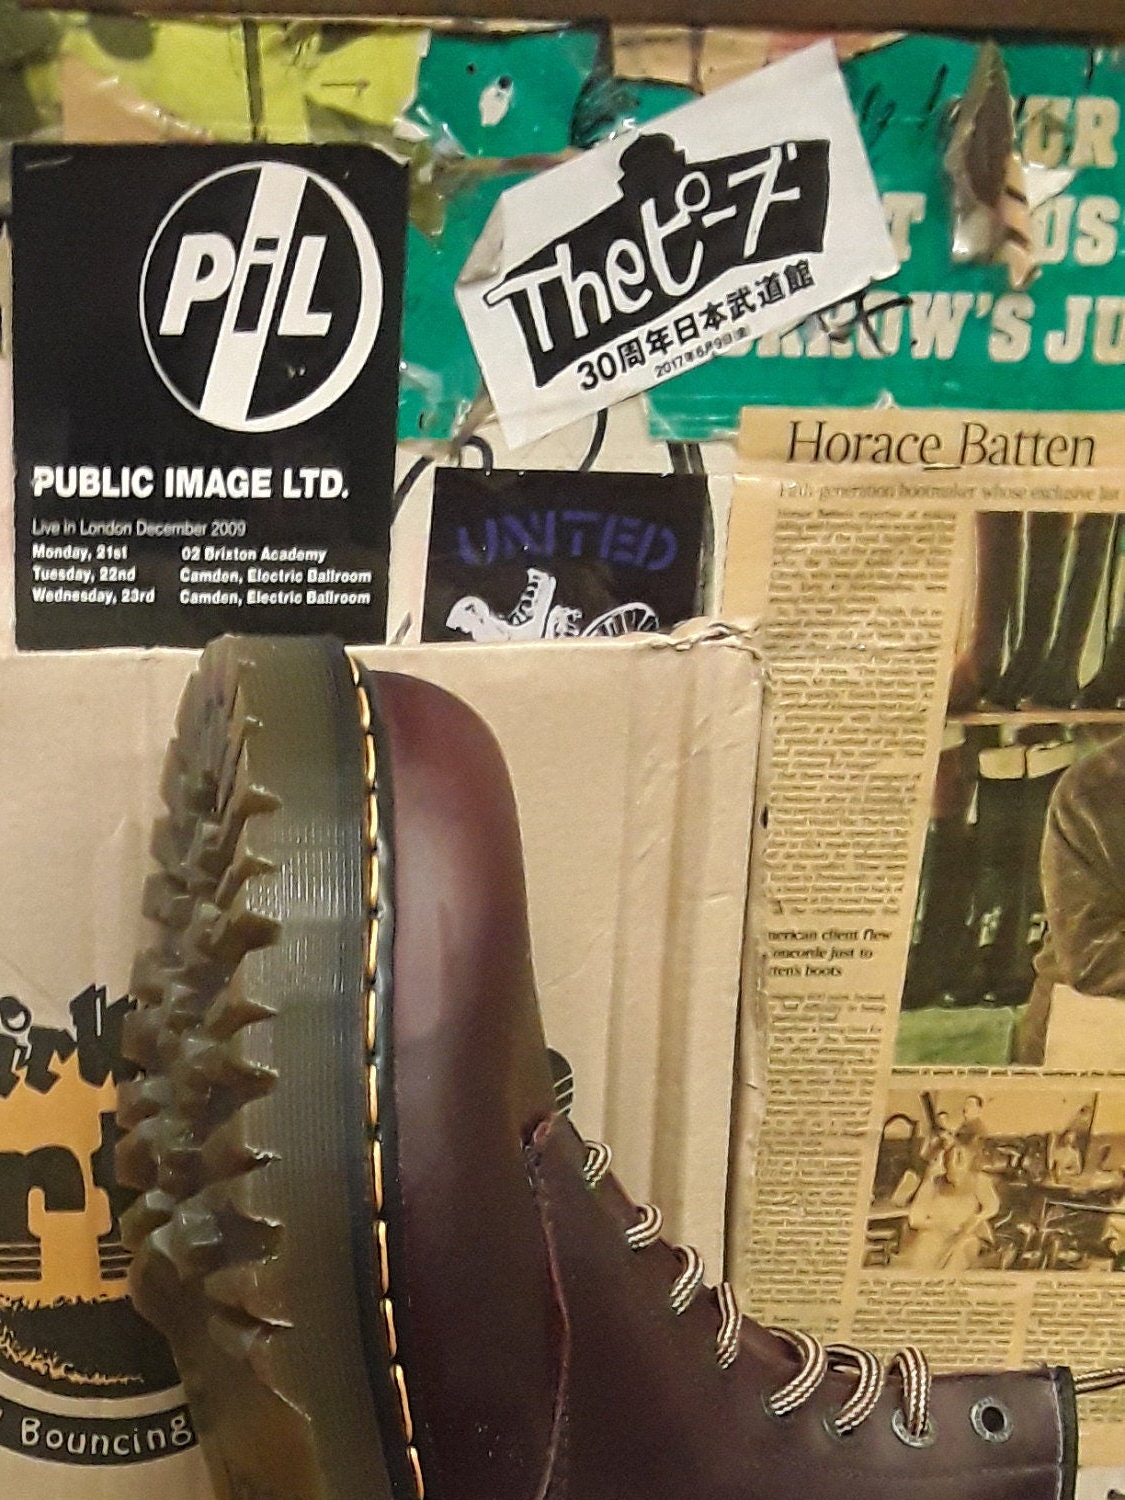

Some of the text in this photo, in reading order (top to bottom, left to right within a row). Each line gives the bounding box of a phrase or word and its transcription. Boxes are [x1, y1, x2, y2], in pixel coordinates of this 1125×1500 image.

[785, 420, 1097, 467] Horace Batten
[32, 464, 350, 500] PUBLIC IMAGE LTD.
[31, 518, 247, 538] Live in London December 2009
[31, 543, 129, 562] Monday, 21st
[204, 546, 328, 565] Brixton Academy
[32, 565, 137, 584] Tuesday, 22nd
[179, 567, 373, 585] Camden, Electric Ballroom
[31, 587, 156, 606] Wednesday, 23rd
[179, 588, 372, 607] Camden, Electric Ballroom
[20, 1413, 194, 1458] Bouncing
